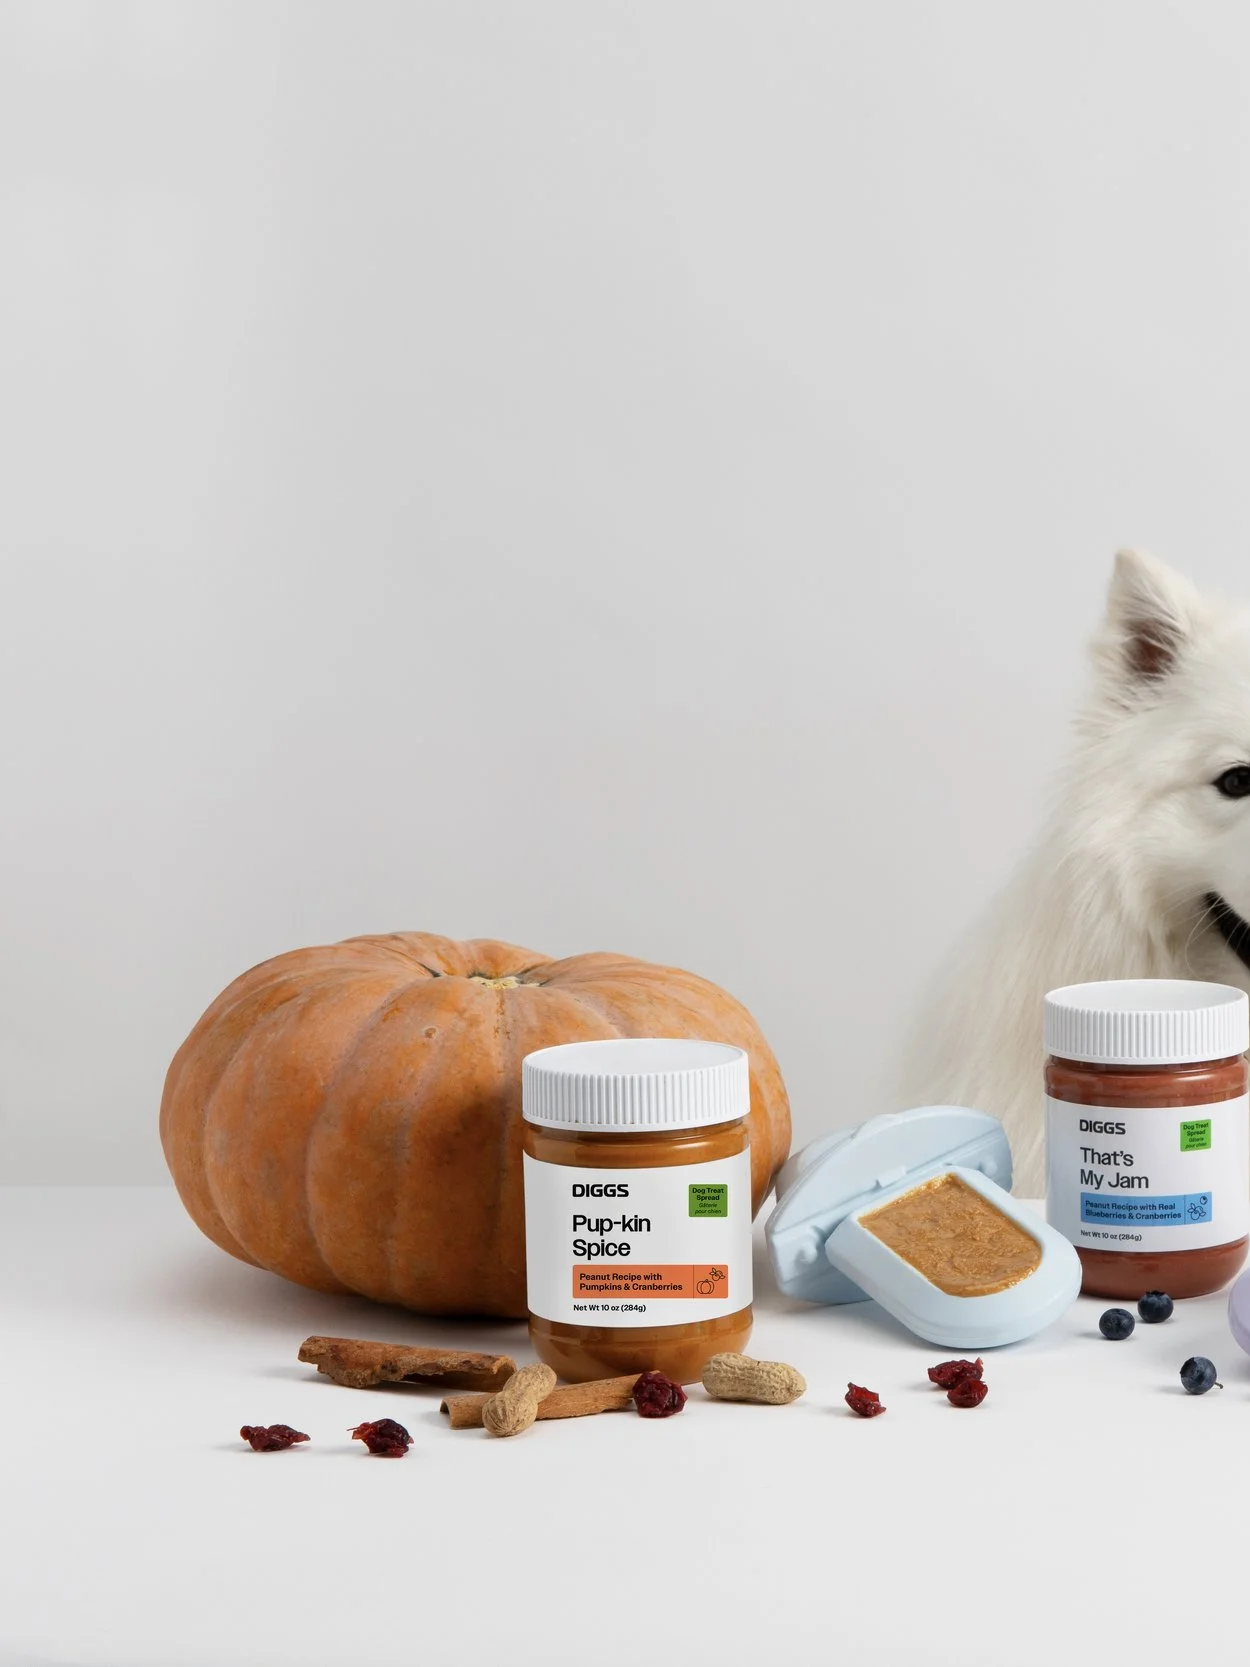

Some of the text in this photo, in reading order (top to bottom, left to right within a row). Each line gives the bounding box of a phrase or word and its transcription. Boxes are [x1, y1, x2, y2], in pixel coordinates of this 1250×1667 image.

[1080, 1119, 1126, 1135] DIGGS
[1080, 1169, 1149, 1190] My Jam
[572, 1184, 629, 1197] DIGGS
[1086, 1200, 1110, 1209] Peanut
[1112, 1203, 1138, 1212] Recipe
[1086, 1210, 1126, 1219] Blueberries
[1136, 1212, 1181, 1220] Cranberries
[573, 1215, 650, 1236] Pup-kin
[573, 1239, 630, 1260] Spice
[612, 1273, 642, 1282] Recipe
[580, 1283, 622, 1292] Pumpkins
[621, 1304, 646, 1312] (284g)
